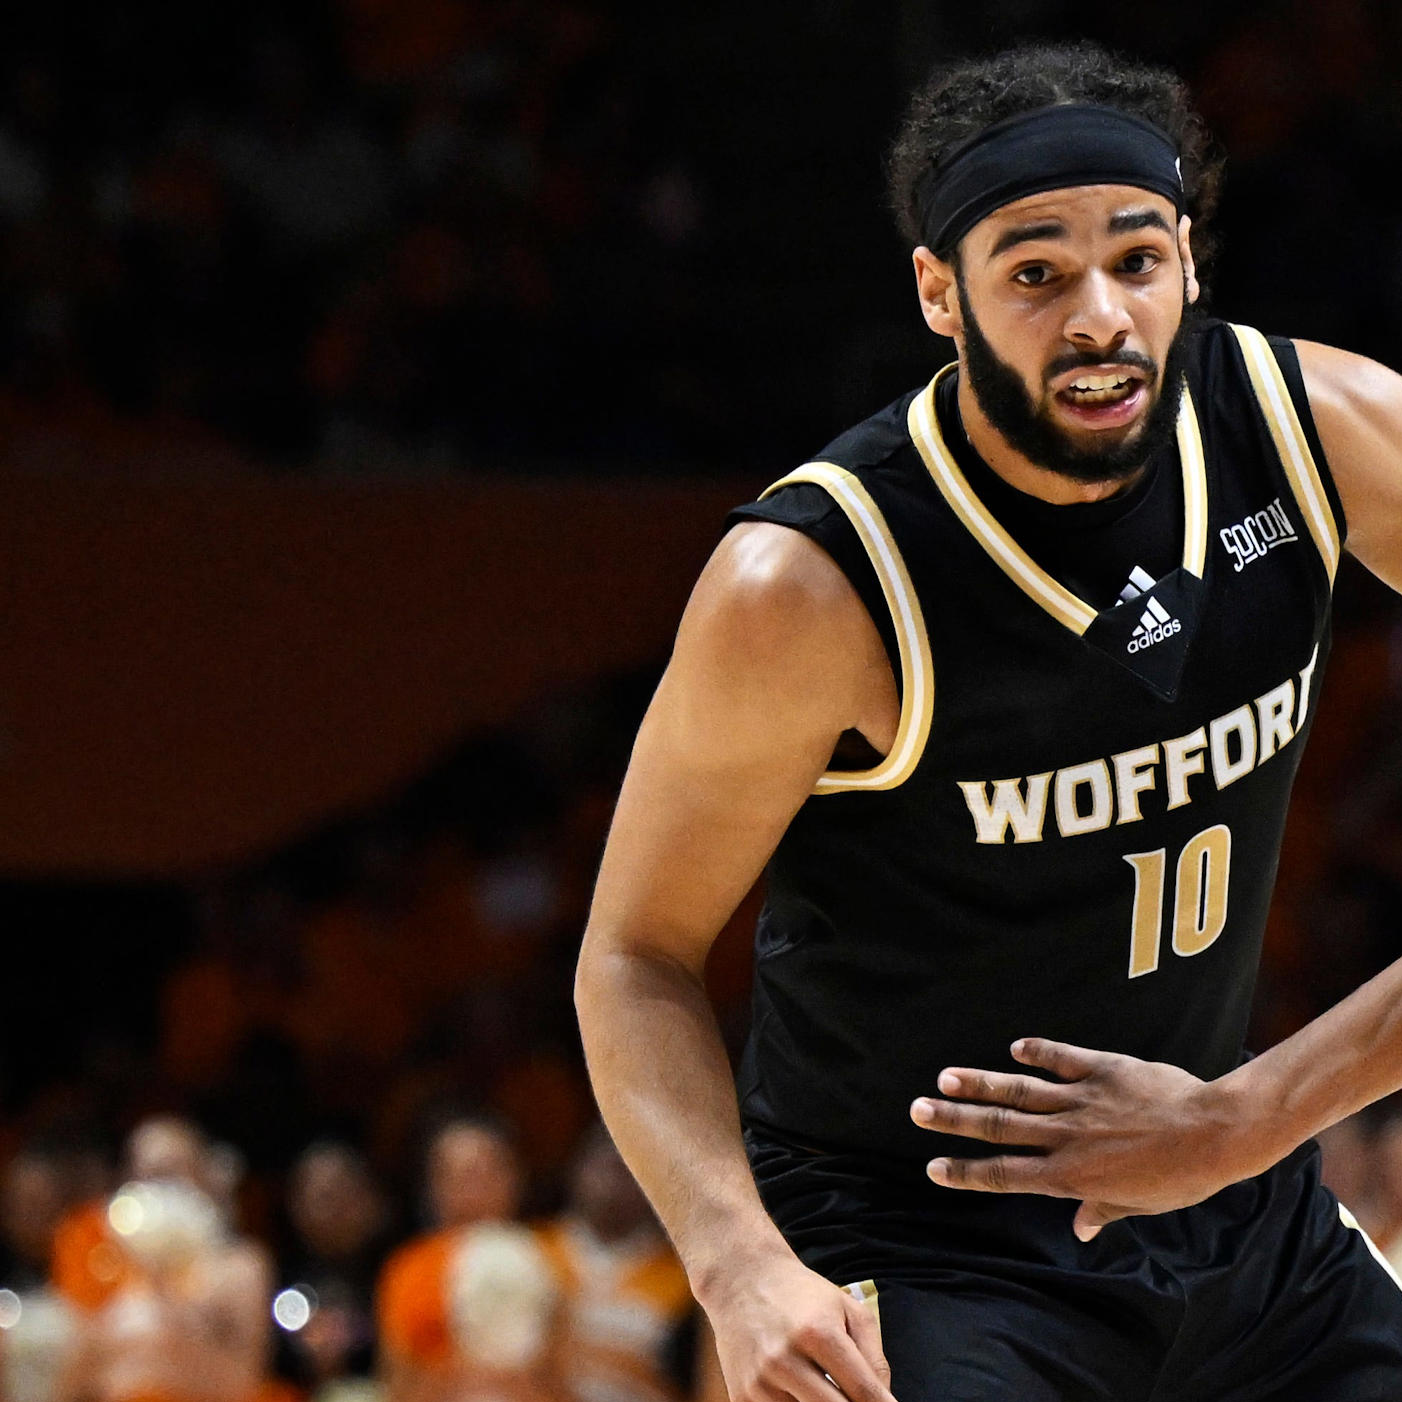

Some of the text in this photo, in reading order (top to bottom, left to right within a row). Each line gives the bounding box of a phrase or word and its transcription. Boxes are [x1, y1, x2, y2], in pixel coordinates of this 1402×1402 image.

[1220, 497, 1298, 573] SOCON
[1127, 617, 1182, 655] adidas
[956, 641, 1320, 844] WOFFOR
[1123, 824, 1232, 979] 10
